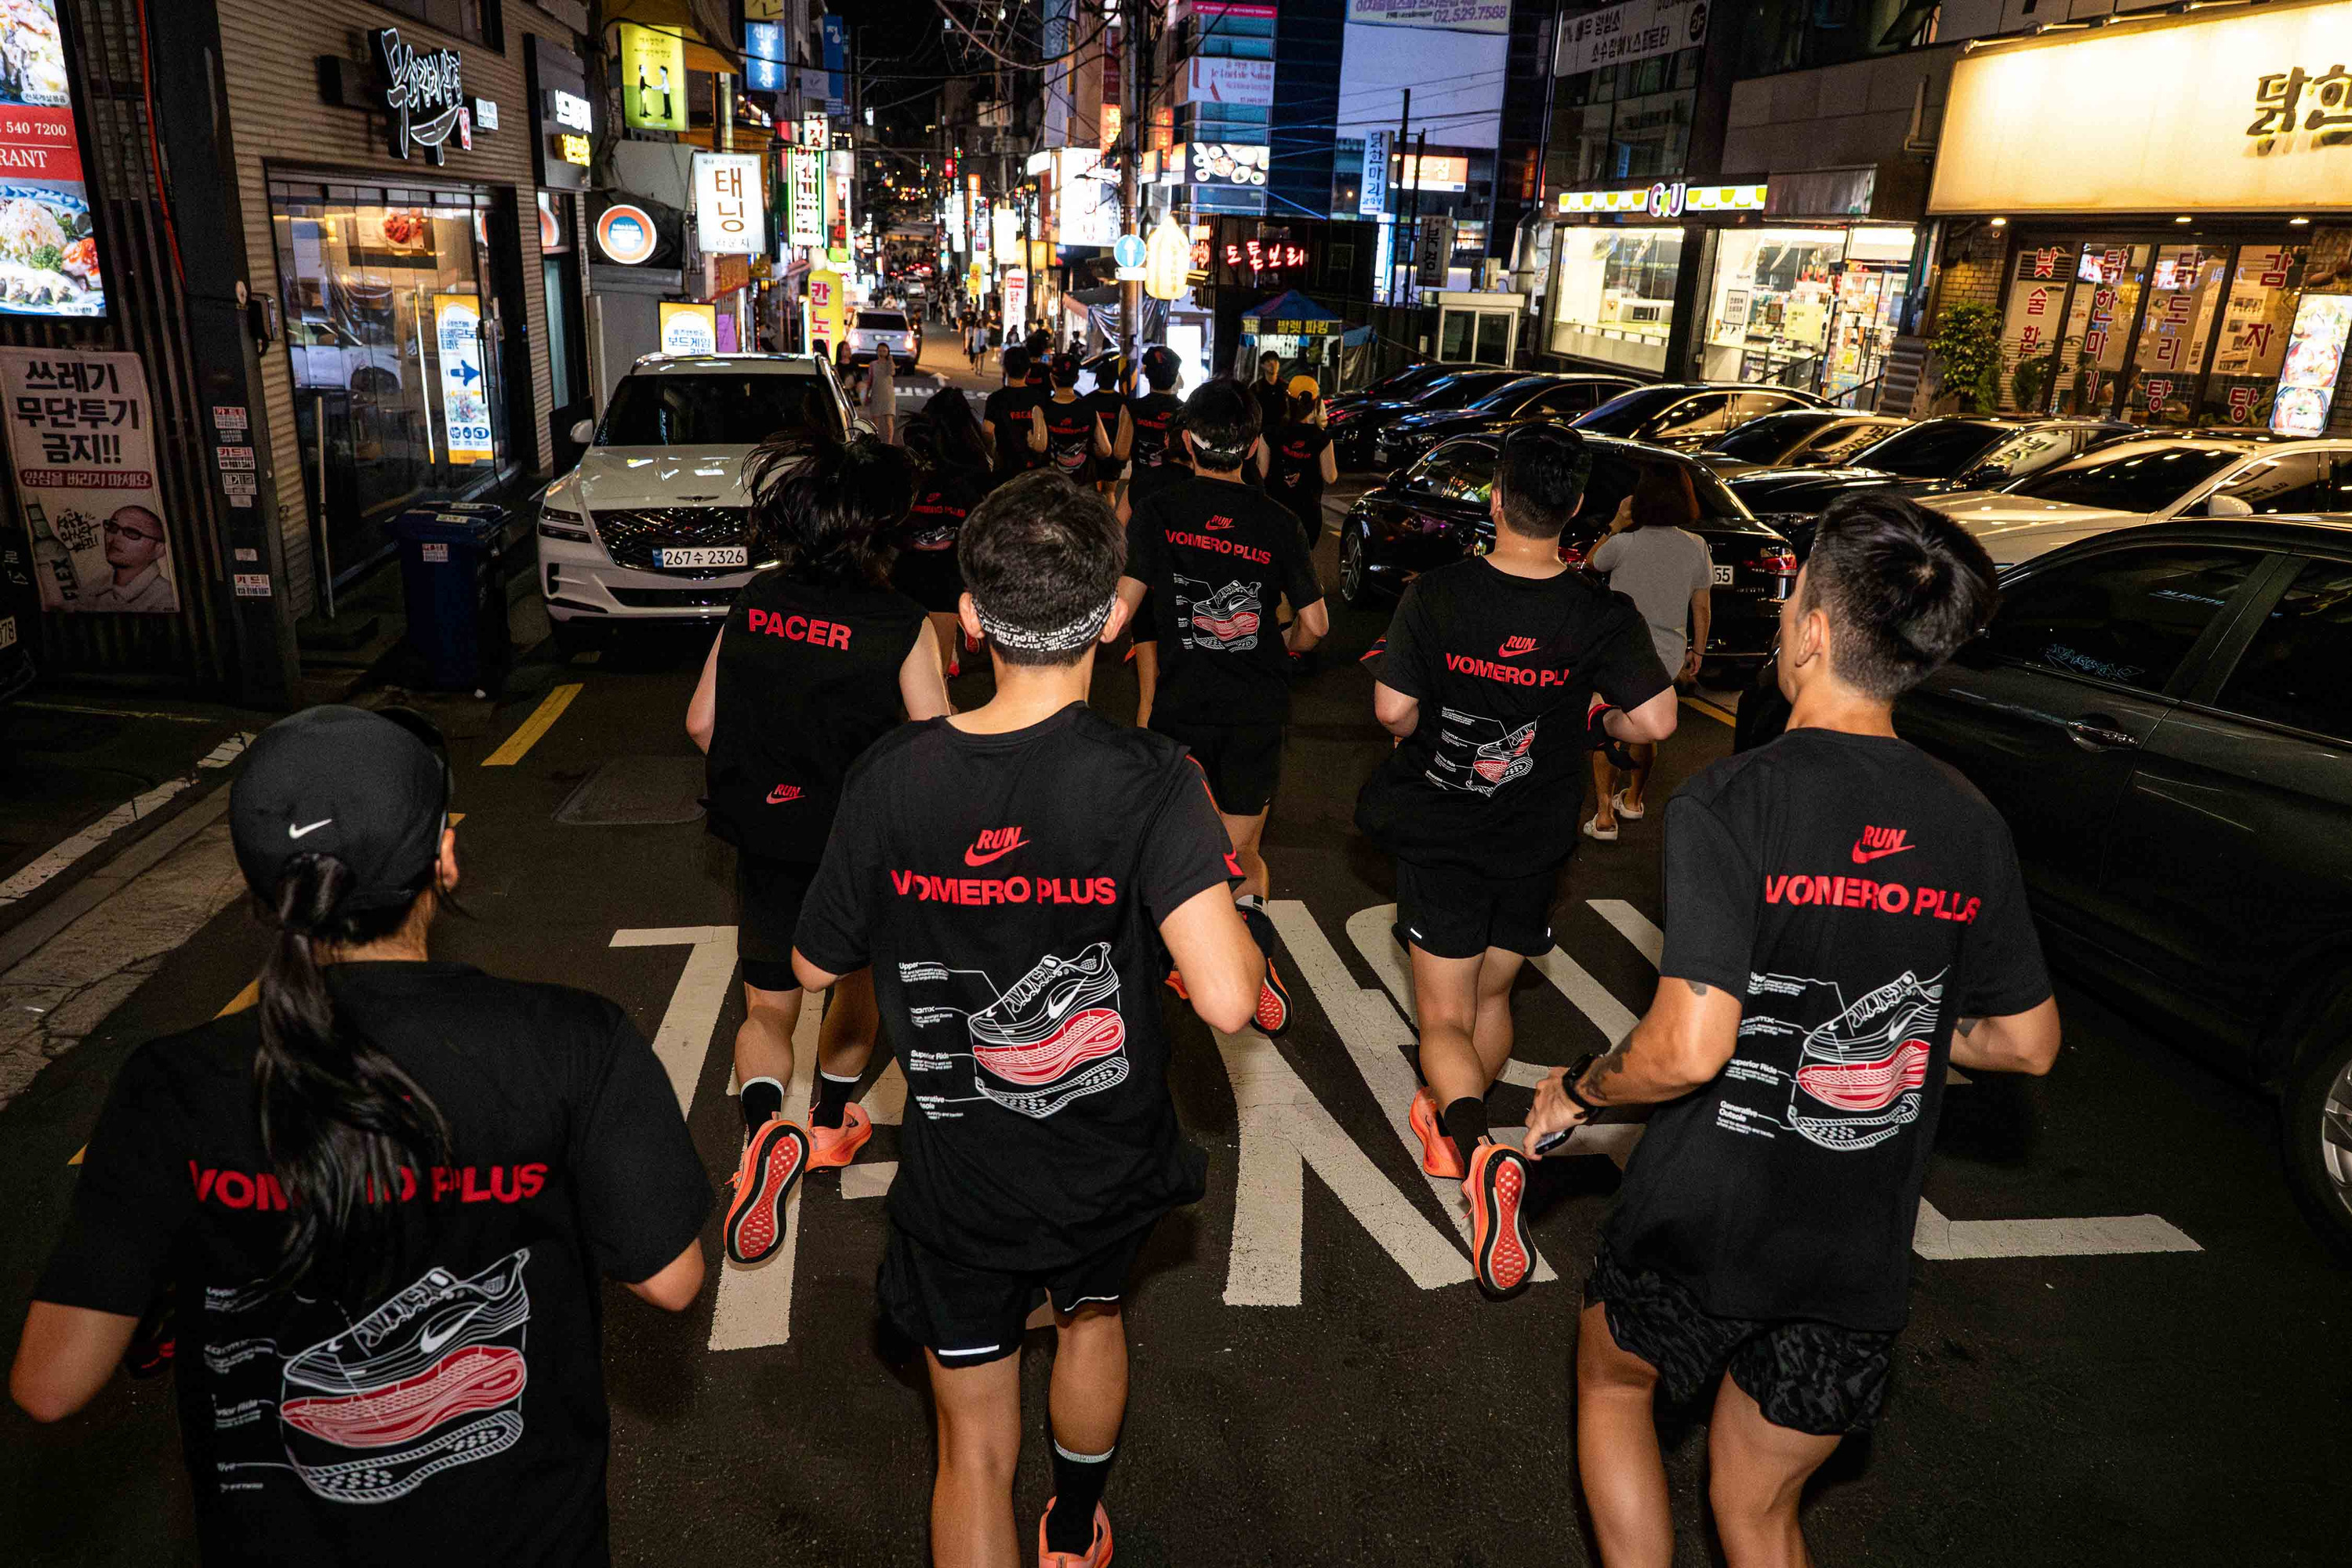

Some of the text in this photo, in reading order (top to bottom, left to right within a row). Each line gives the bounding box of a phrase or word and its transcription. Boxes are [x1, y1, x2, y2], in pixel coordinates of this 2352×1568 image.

[6, 122, 67, 136] 540 7200
[715, 168, 744, 232] 태닝
[1649, 183, 1686, 217] CU
[1227, 241, 1305, 270] 도톤보리
[2019, 246, 2060, 354] 낮술환
[1277, 320, 1329, 334] 발렛 파킹
[2084, 247, 2129, 404] 닭한마리
[2146, 249, 2205, 414] 닭도리탕
[2227, 252, 2295, 424] 감자탕
[669, 336, 710, 348] 보드게임
[25, 361, 120, 394] 쓰레기
[16, 397, 140, 430] 무단투기
[42, 433, 122, 464] 금지!!
[24, 470, 148, 487] 양심을 버리지 마세요
[1211, 514, 1233, 526] RUN
[664, 550, 744, 565] 267수 2326
[1165, 529, 1272, 564] VOMERO PLUS
[749, 608, 851, 650] PACER
[1505, 636, 1536, 649] RUN
[1446, 653, 1536, 686] VOMERO
[774, 784, 800, 797] RUN
[975, 827, 1022, 850] RUN
[1863, 826, 1906, 850] RUN
[891, 869, 1116, 905] VOMERO PLUS
[1760, 1063, 1778, 1075] Ride
